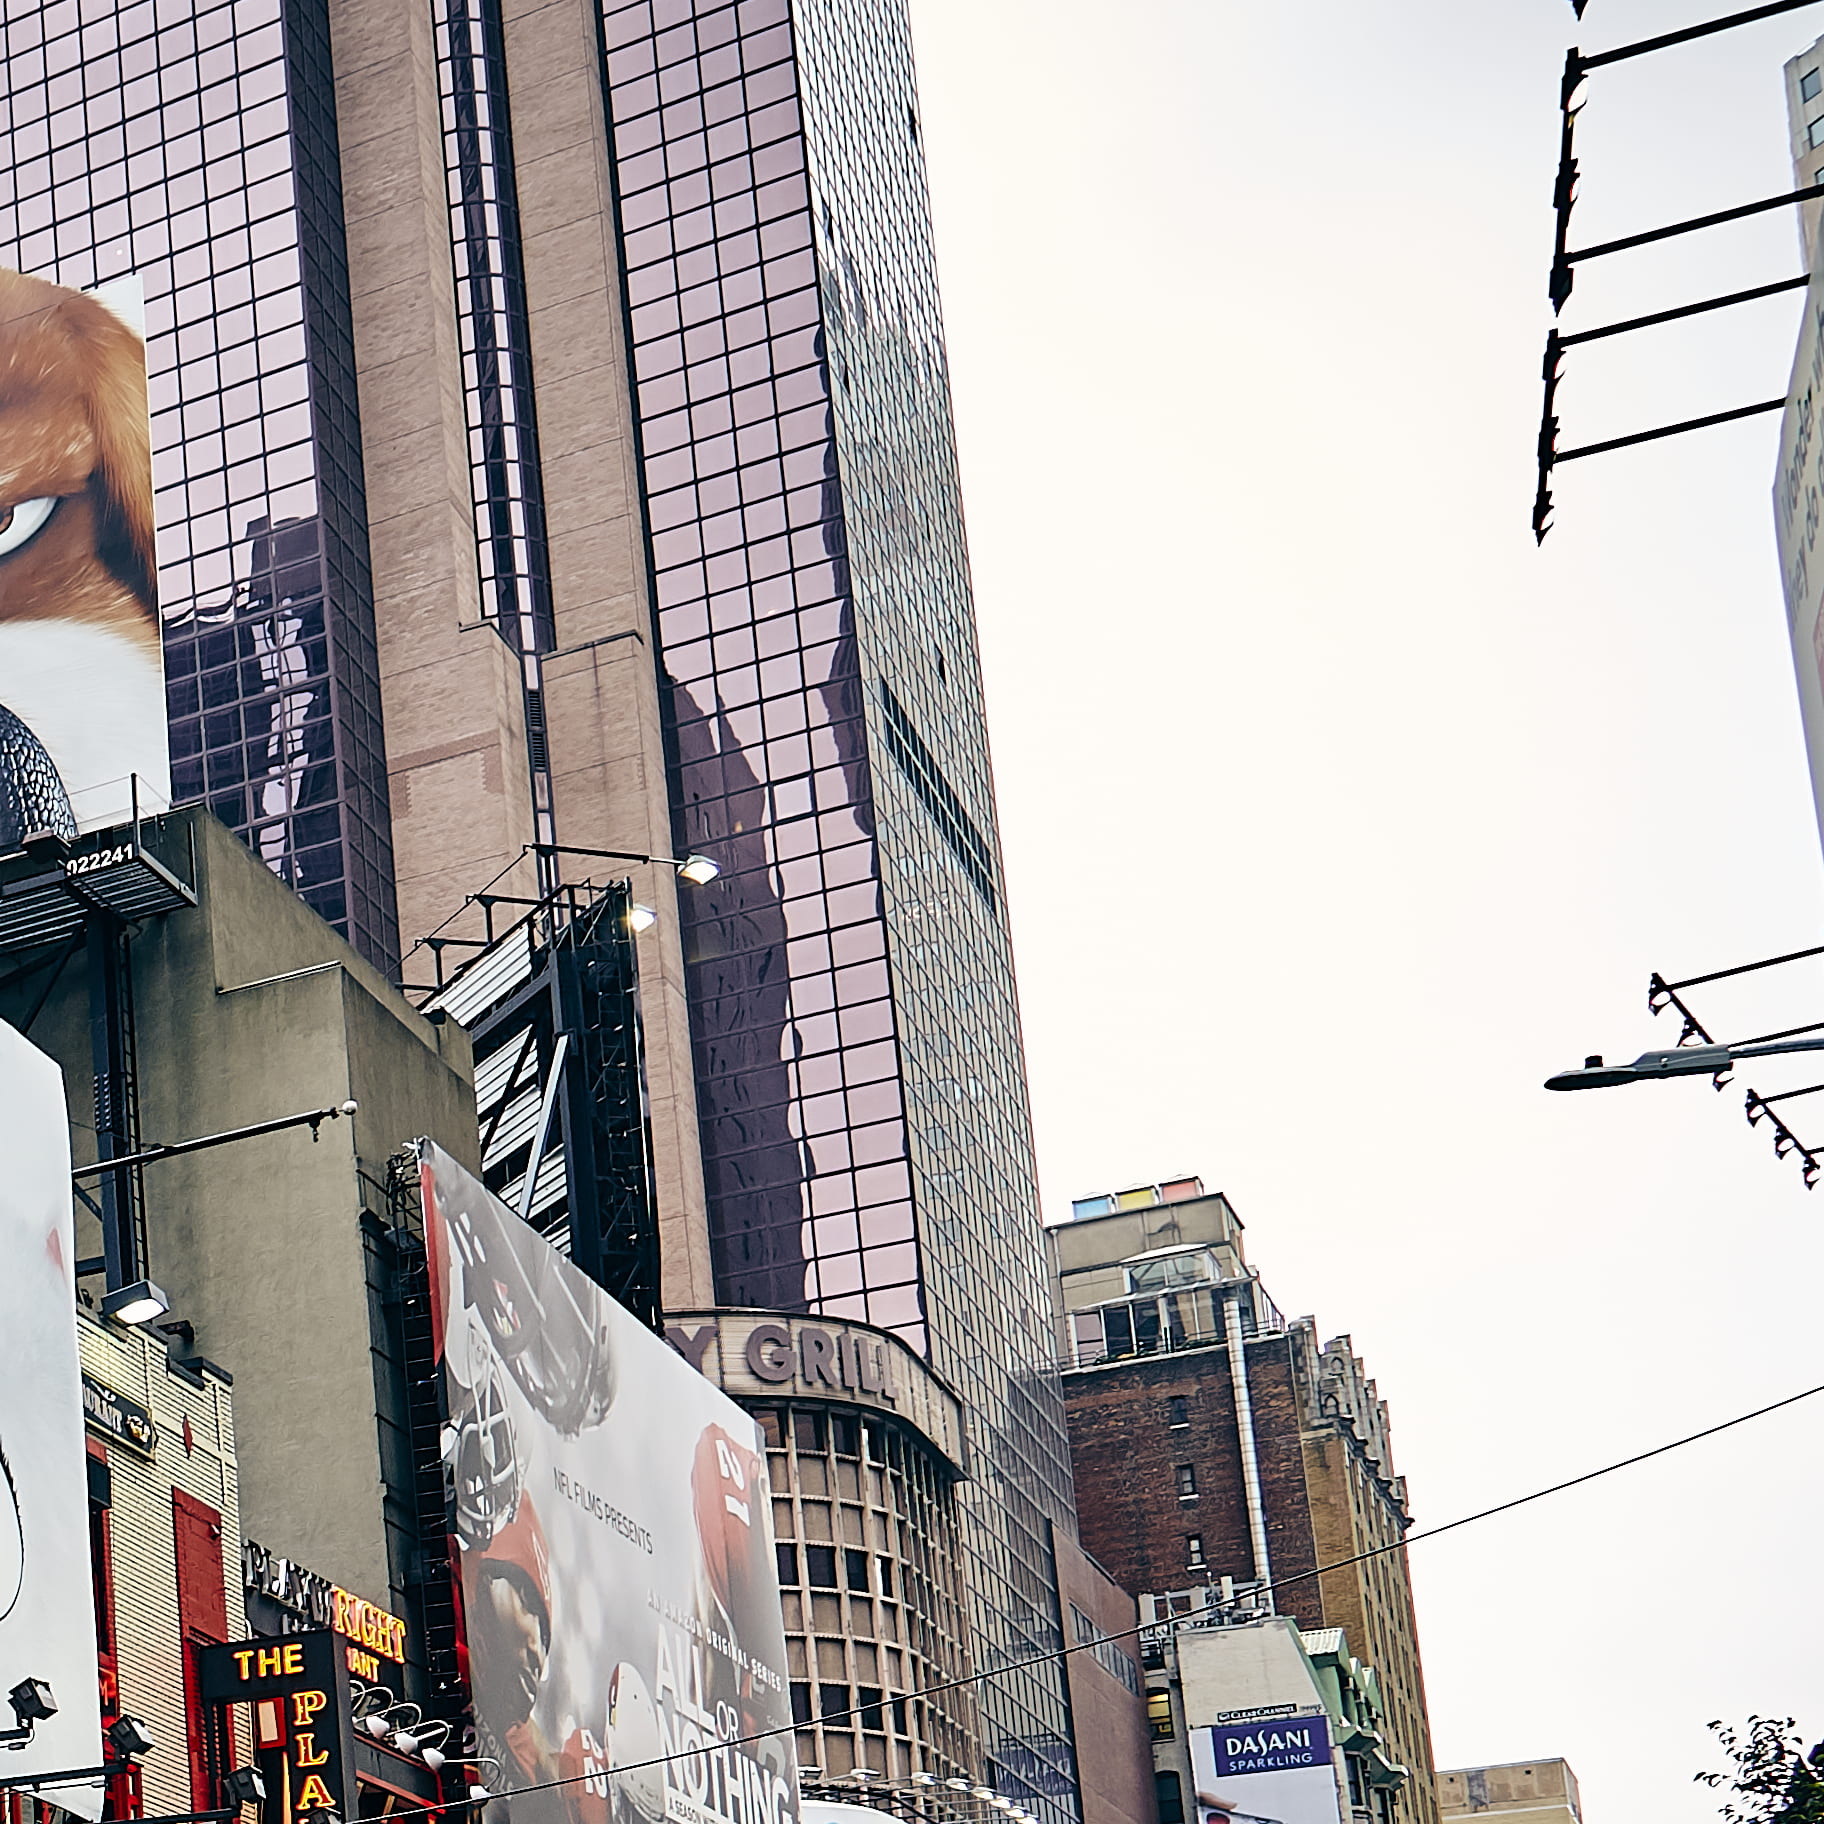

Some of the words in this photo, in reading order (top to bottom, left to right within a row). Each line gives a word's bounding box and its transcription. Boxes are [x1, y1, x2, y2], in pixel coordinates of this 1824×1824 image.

[66, 843, 133, 877] 022241
[745, 1322, 898, 1403] GRILL
[554, 1466, 573, 1497] NFL
[574, 1482, 602, 1516] FILMS
[605, 1501, 653, 1555] PRESENTS
[232, 1643, 305, 1681] THE
[706, 1626, 749, 1669] ORIGINAL
[751, 1656, 781, 1693] SERIES
[655, 1624, 716, 1735] ALL
[715, 1699, 741, 1750] OR
[1225, 1728, 1311, 1758] DASANI
[1229, 1752, 1313, 1772] SPARKLING
